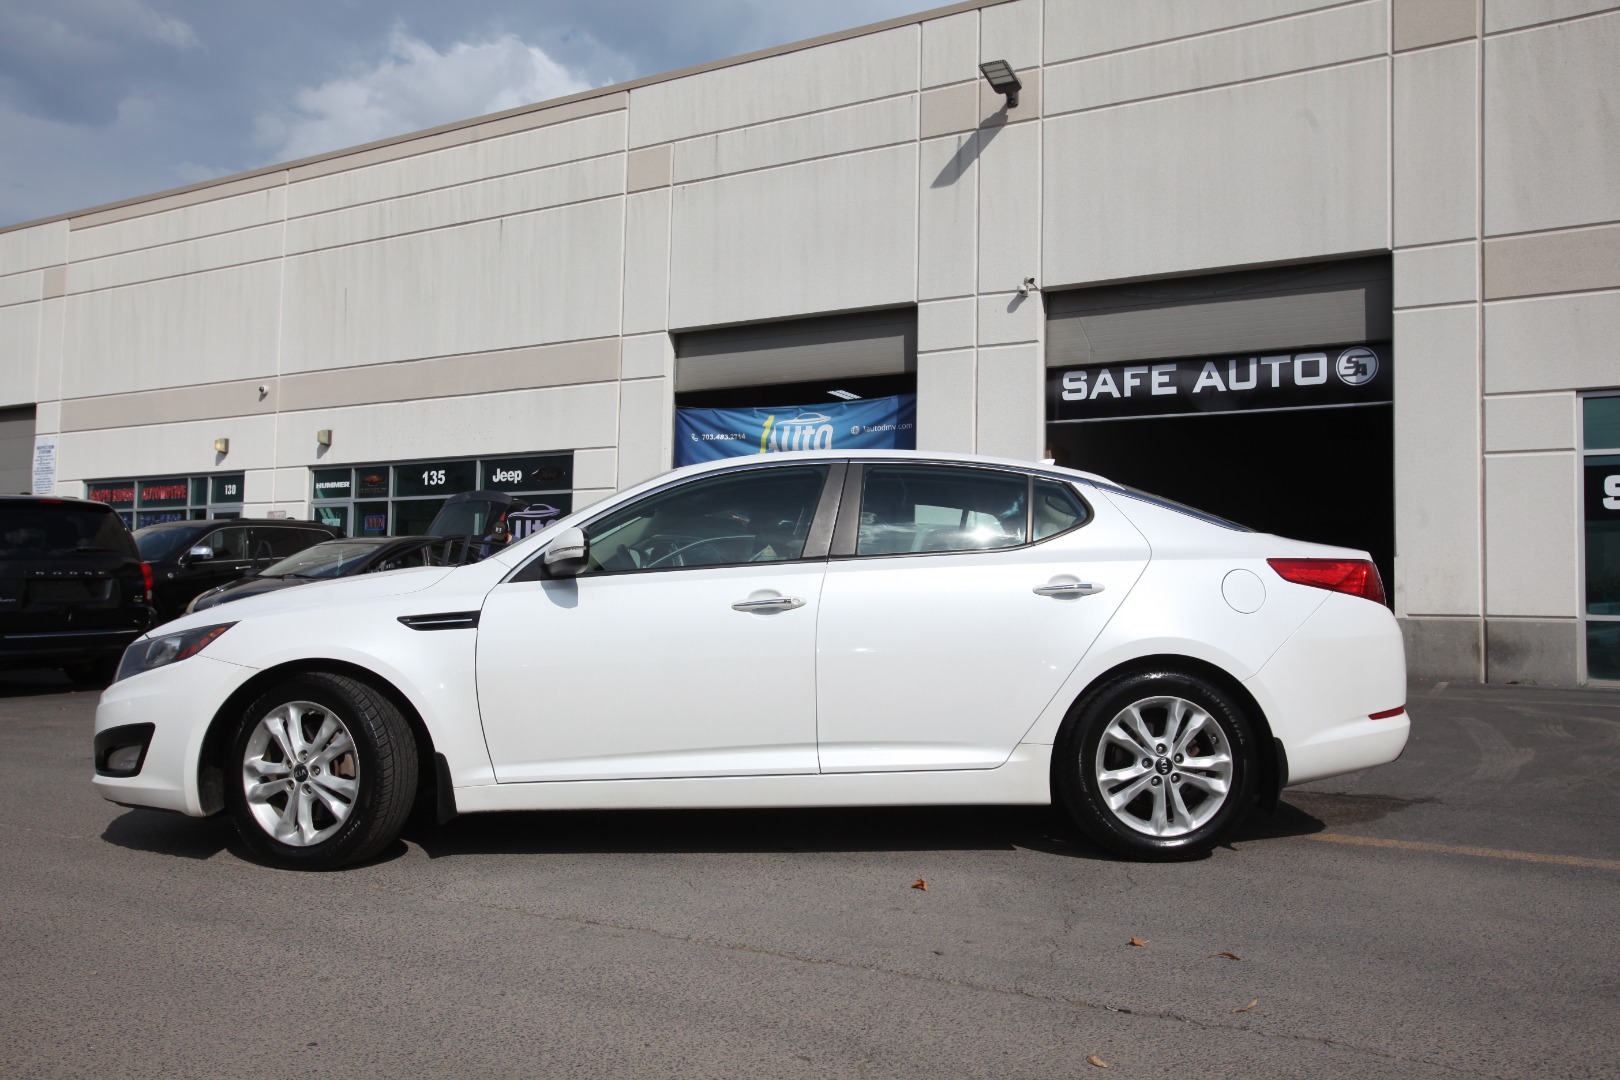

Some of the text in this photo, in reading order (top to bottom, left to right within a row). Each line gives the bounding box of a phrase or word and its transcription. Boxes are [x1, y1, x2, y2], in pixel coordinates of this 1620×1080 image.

[1061, 352, 1328, 401] SAFE AUTO
[422, 469, 446, 486] 135
[492, 468, 523, 484] Jeep
[141, 484, 187, 501] AUTOMOTIVE
[224, 484, 237, 495] 130
[315, 481, 351, 489] HUMMER
[293, 769, 307, 778] KIA
[1160, 758, 1168, 774] KIA
